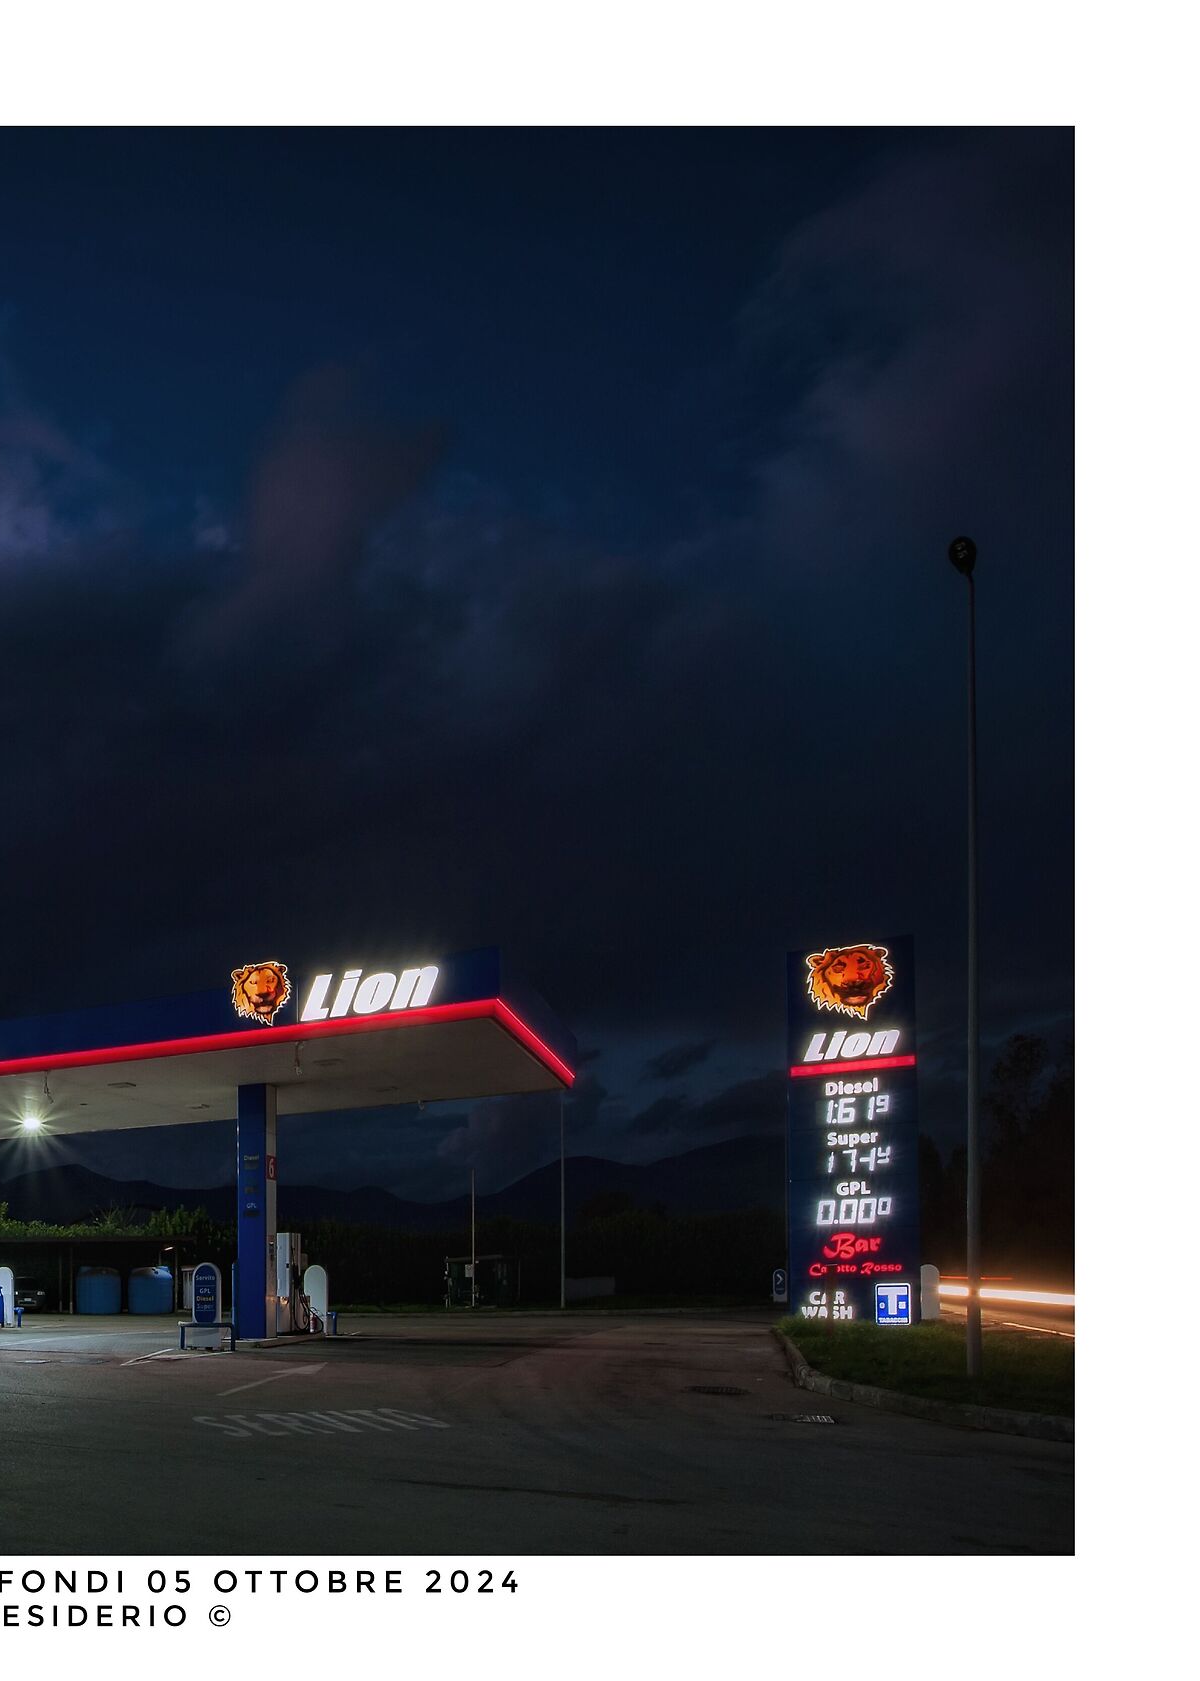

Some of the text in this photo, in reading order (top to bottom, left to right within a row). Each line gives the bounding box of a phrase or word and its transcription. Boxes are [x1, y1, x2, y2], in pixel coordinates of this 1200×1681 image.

[301, 965, 439, 1021] Lion
[803, 1029, 900, 1062] Lion
[826, 1077, 878, 1096] Diesel
[827, 1132, 878, 1147] Super
[268, 1158, 275, 1178] 6
[836, 1181, 871, 1196] GPL
[823, 1232, 881, 1259] Bar
[860, 1261, 902, 1275] Rosso
[878, 1286, 908, 1315] T
[191, 1407, 451, 1437] SERVITO
